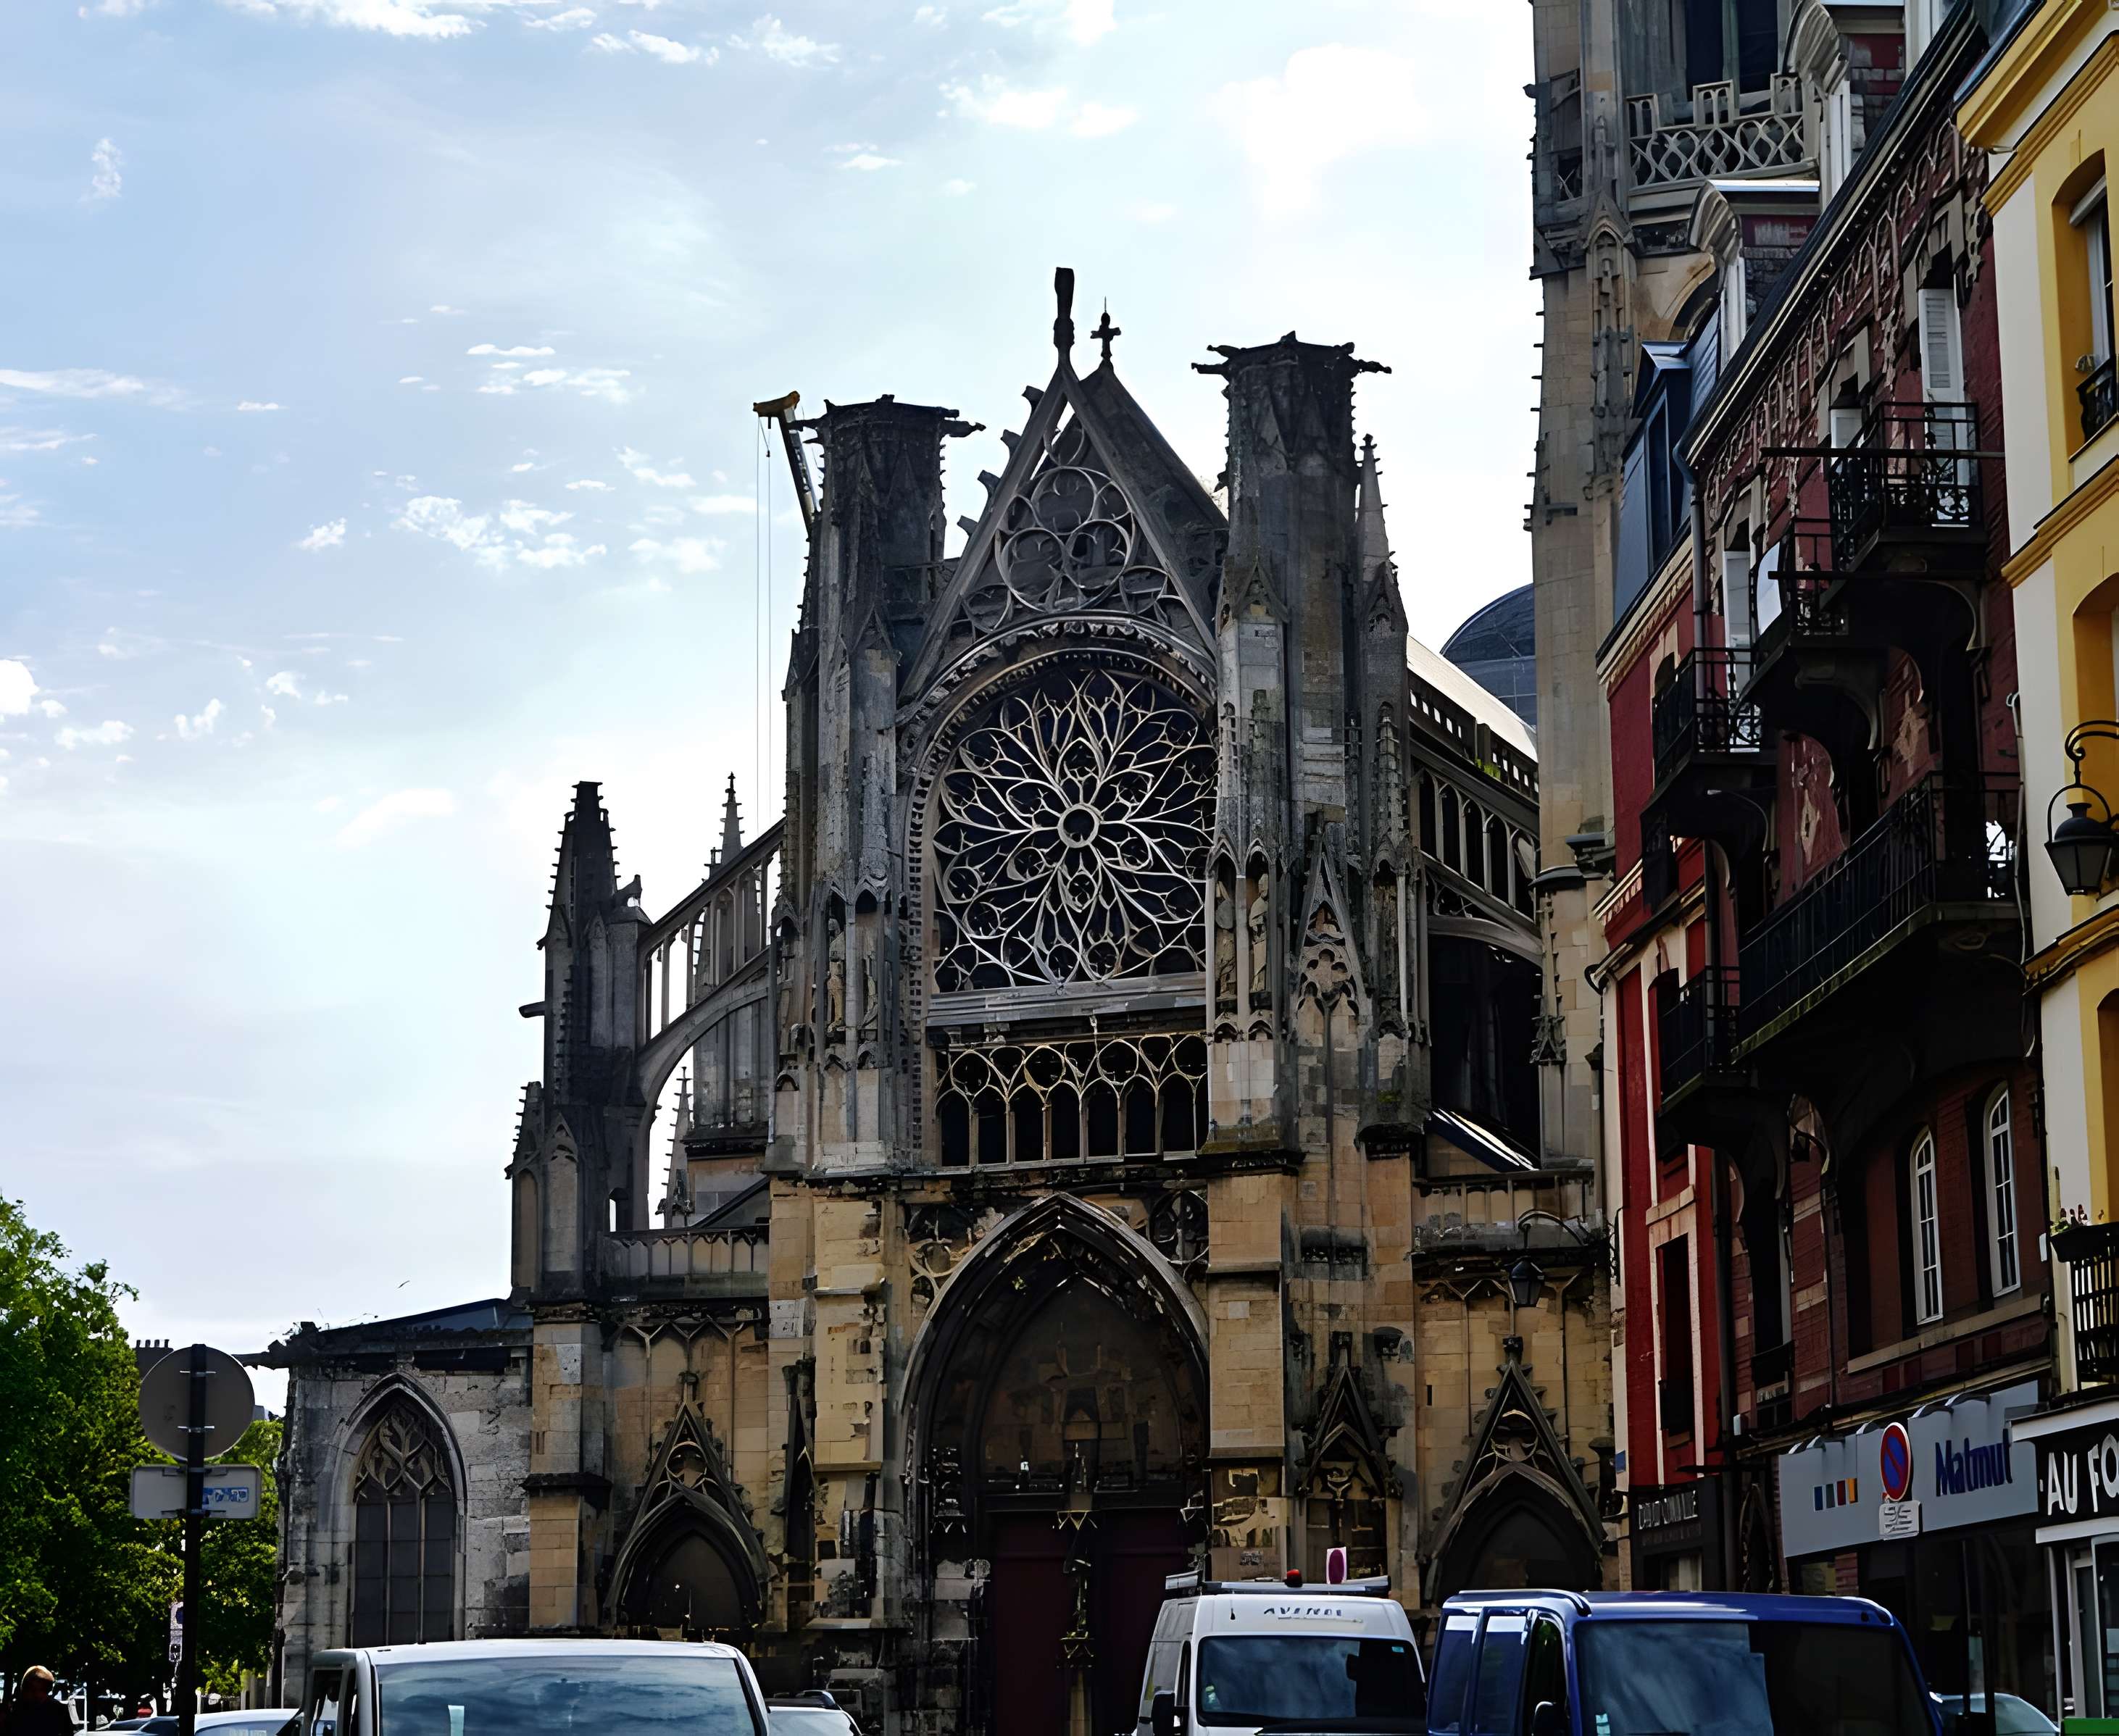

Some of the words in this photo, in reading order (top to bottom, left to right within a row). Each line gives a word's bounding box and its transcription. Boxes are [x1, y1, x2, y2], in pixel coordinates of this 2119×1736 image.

[1935, 1428, 2012, 1497] Matmut
[2047, 1451, 2078, 1516] AU
[2087, 1433, 2119, 1512] FO
